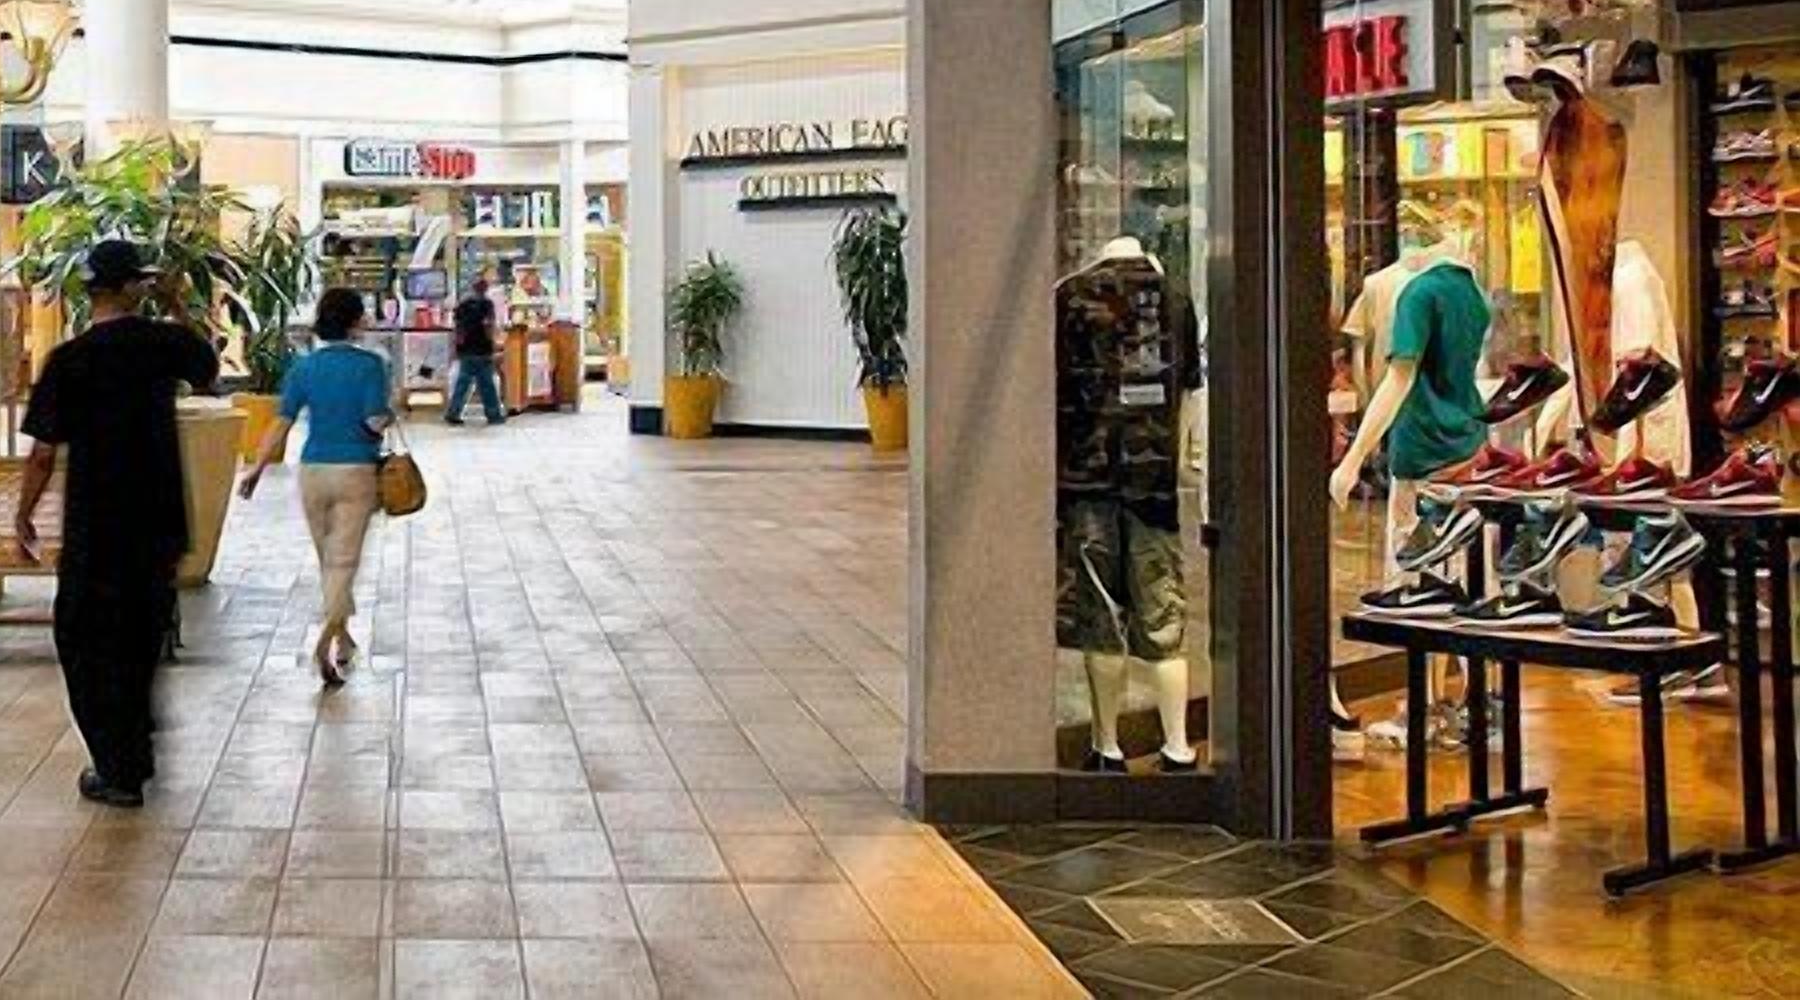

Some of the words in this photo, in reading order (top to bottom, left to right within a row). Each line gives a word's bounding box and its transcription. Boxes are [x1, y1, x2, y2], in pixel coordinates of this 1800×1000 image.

[688, 119, 834, 159] AMERICAN
[851, 115, 908, 147] EAG
[740, 169, 886, 199] OUTFITTERS
